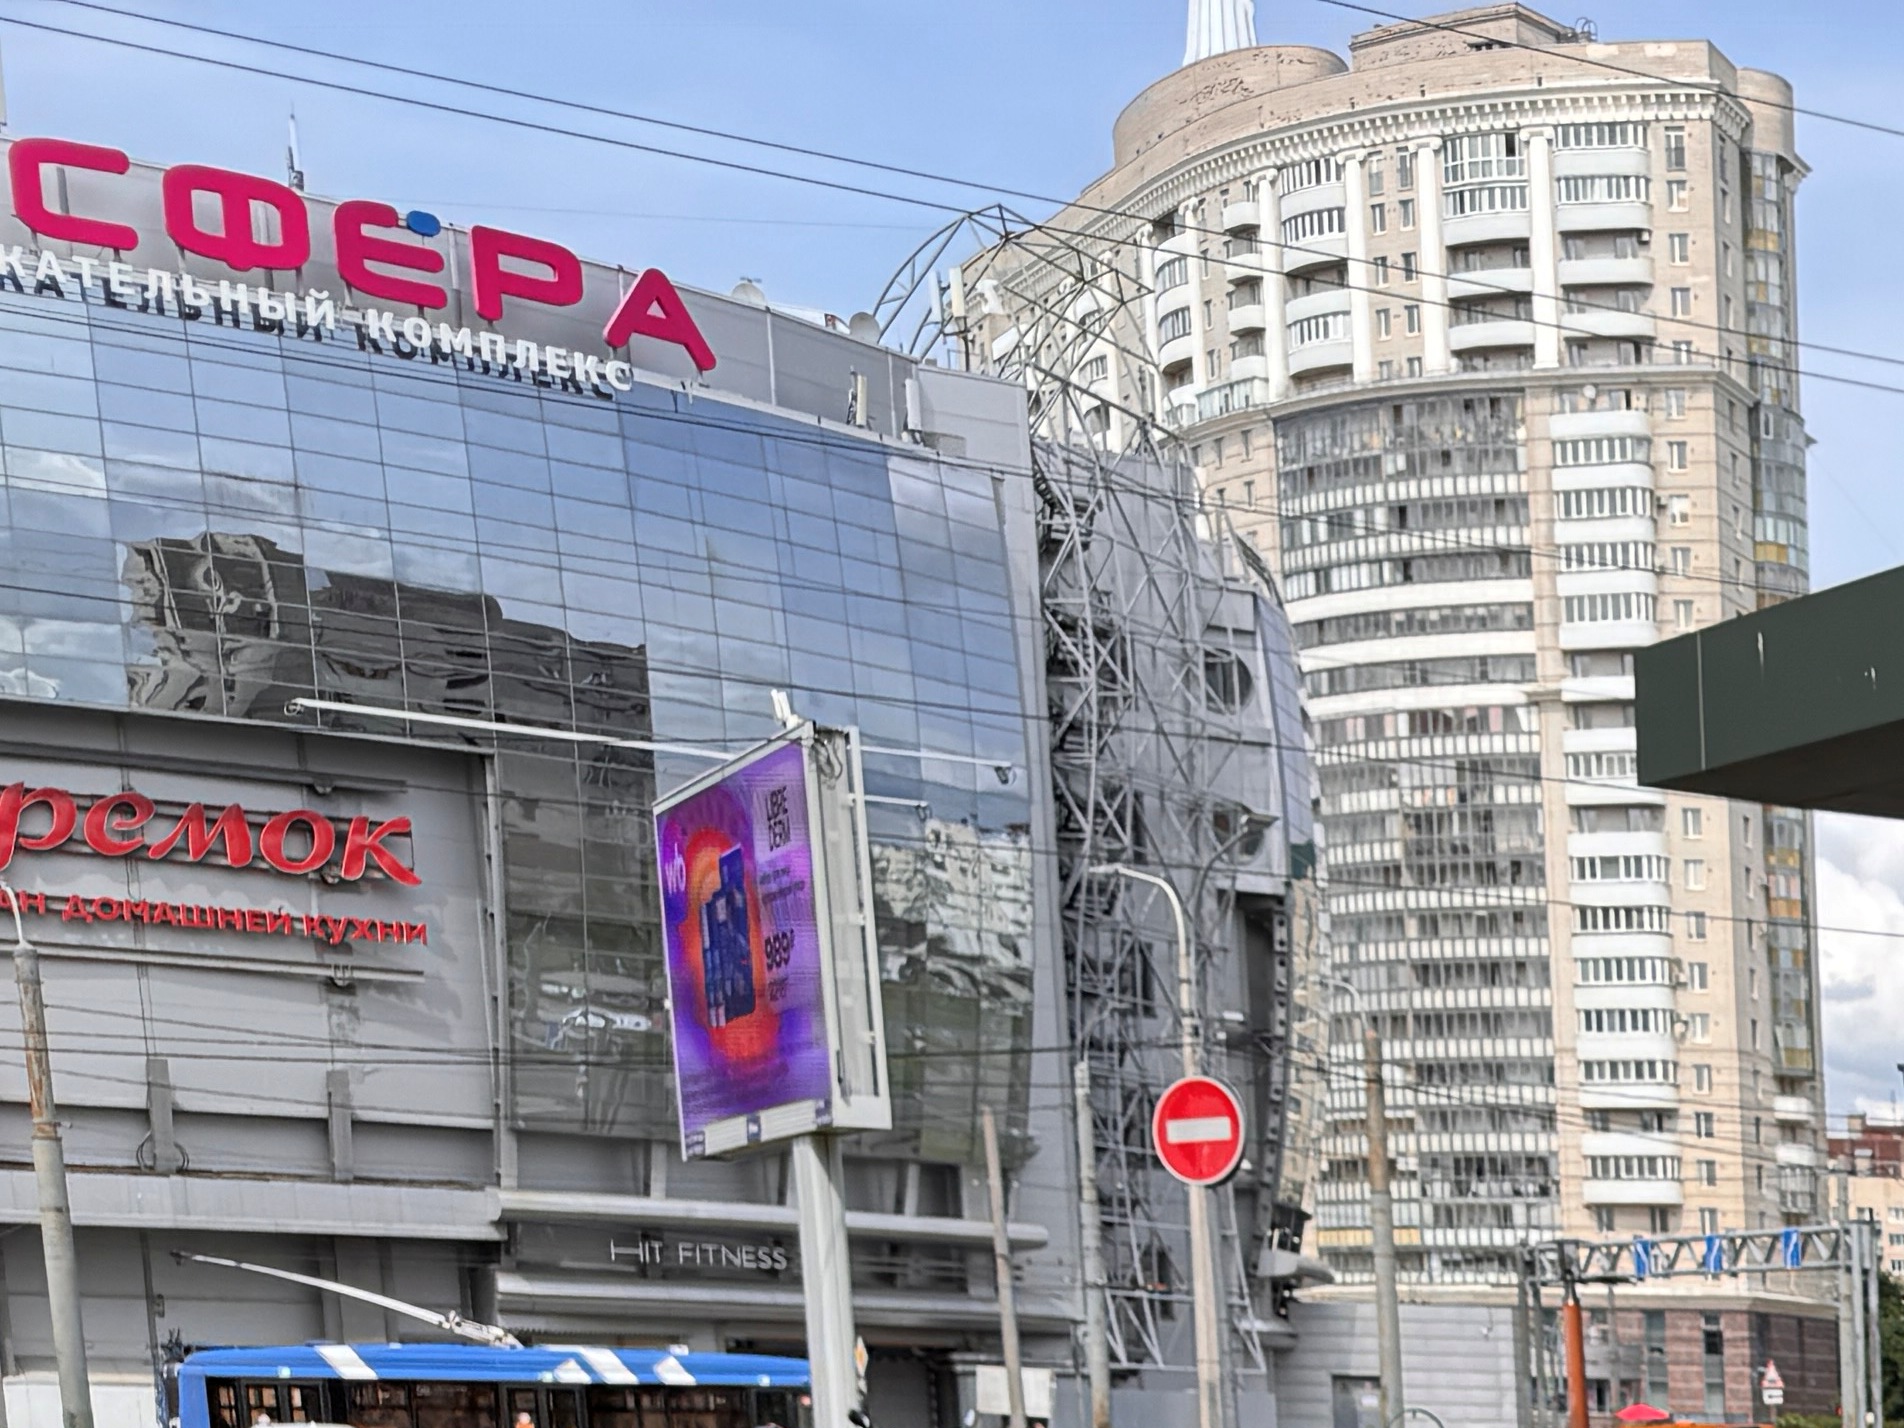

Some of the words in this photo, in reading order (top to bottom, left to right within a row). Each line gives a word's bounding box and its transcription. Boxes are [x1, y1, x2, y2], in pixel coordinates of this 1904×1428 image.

[8, 137, 716, 371] СФЕРА
[367, 308, 633, 392] КОМПЛЕКС
[62, 894, 292, 936] ДОМАШНЕЙ
[302, 912, 428, 945] КУХНИ
[610, 1238, 664, 1264] HIT
[678, 1241, 788, 1270] FITNESS
